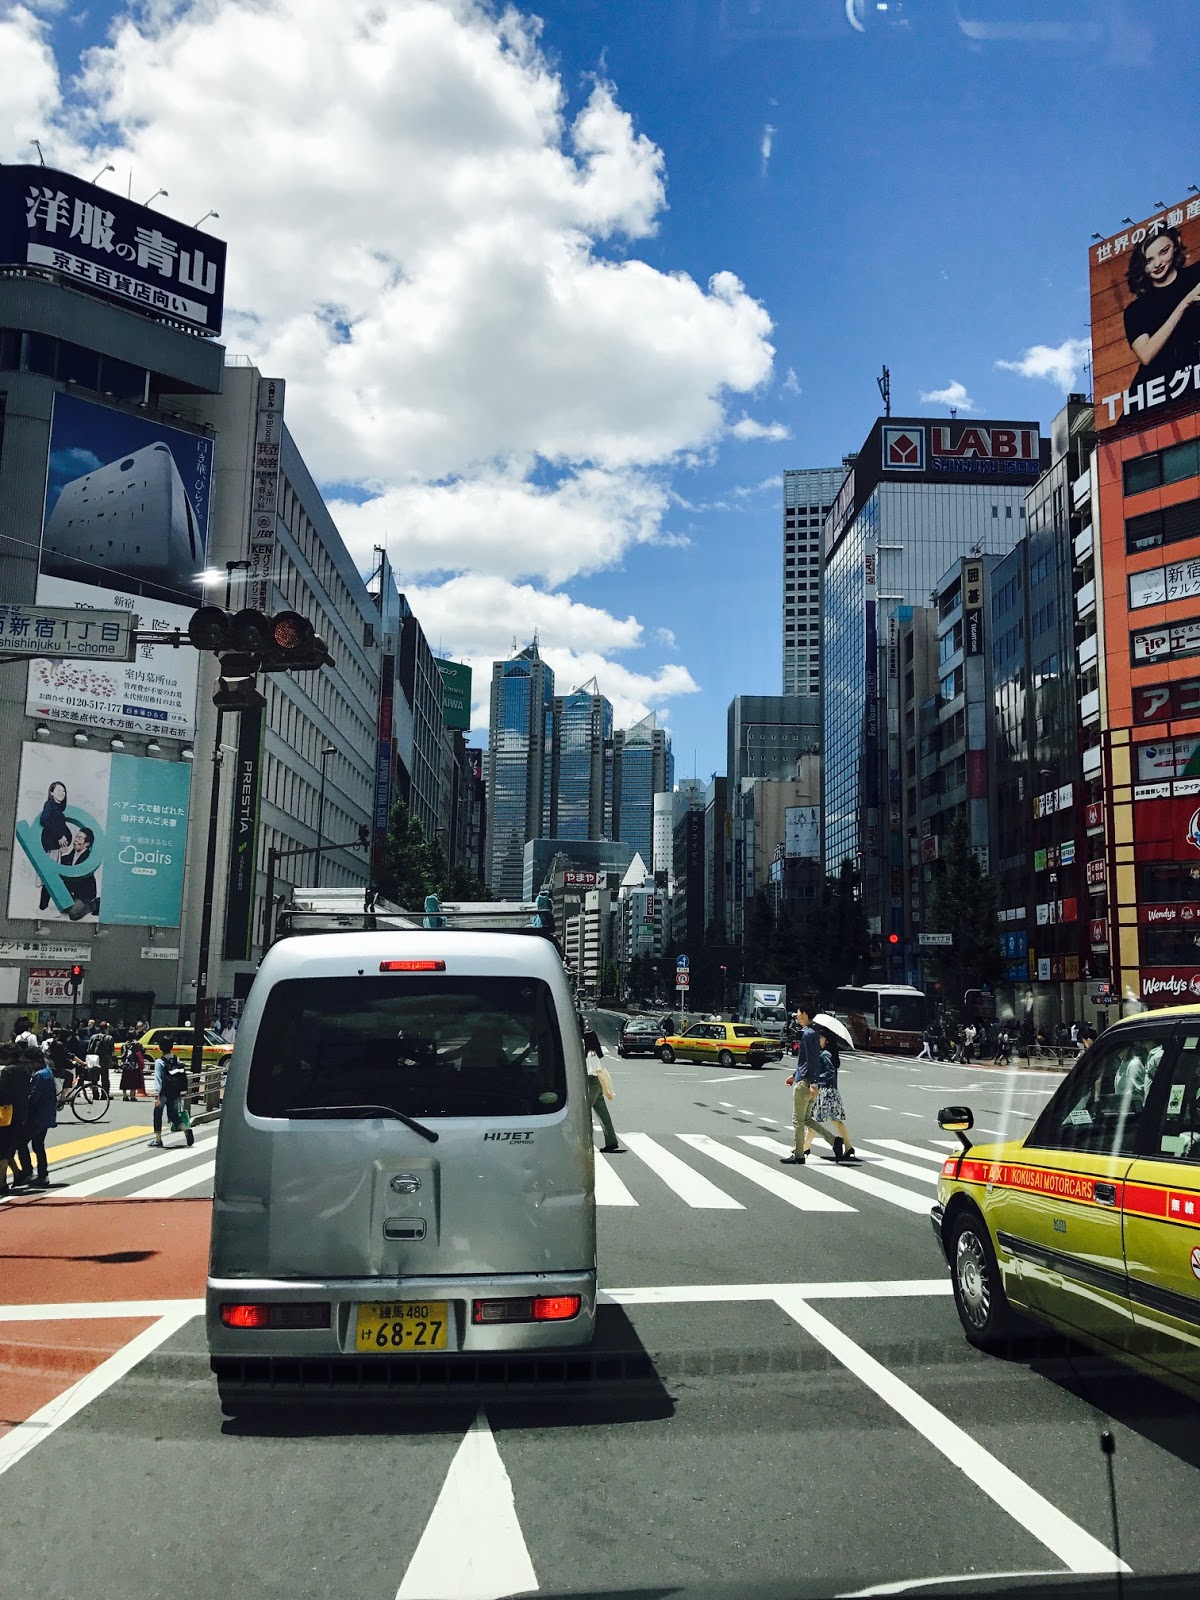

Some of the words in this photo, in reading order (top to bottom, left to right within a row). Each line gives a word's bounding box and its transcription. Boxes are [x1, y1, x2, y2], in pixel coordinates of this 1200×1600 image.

[25, 186, 217, 295] 洋服の青山
[52, 251, 188, 313] 京王百貨店向い
[931, 426, 1040, 459] LABI
[931, 458, 1000, 474] SHINJUKU
[252, 544, 272, 554] KEN
[262, 554, 270, 577] パソコン
[1168, 561, 1200, 583] 新宿
[113, 596, 135, 610] 新宿
[65, 641, 116, 659] 1-chome
[140, 643, 154, 660] 堂
[66, 696, 122, 714] 0120-517-177
[51, 708, 142, 730] 当交差点代々木方面へ
[145, 723, 187, 738] 2本目右折
[239, 760, 252, 833] PRESTÍA
[380, 784, 388, 805] TOTAL
[113, 801, 185, 816] ペアーズで結ばれた
[121, 814, 177, 827] 由井さんご夫妻
[378, 807, 387, 829] CLUB
[134, 850, 172, 865] pairs
[566, 872, 594, 882] やまや
[1148, 908, 1176, 922] Wendy's
[45, 986, 63, 996] 利息
[1142, 975, 1187, 996] Wendy's
[484, 1131, 534, 1142] HIJET
[982, 1165, 1008, 1182] TAXI
[1011, 1168, 1044, 1188] KOKUSAI
[1043, 1175, 1093, 1199] MOTORCARS
[1171, 1198, 1195, 1214] 無線
[379, 1306, 404, 1319] 練馬
[406, 1306, 429, 1318] 480
[361, 1329, 373, 1341] け
[376, 1322, 443, 1347] 68-27
